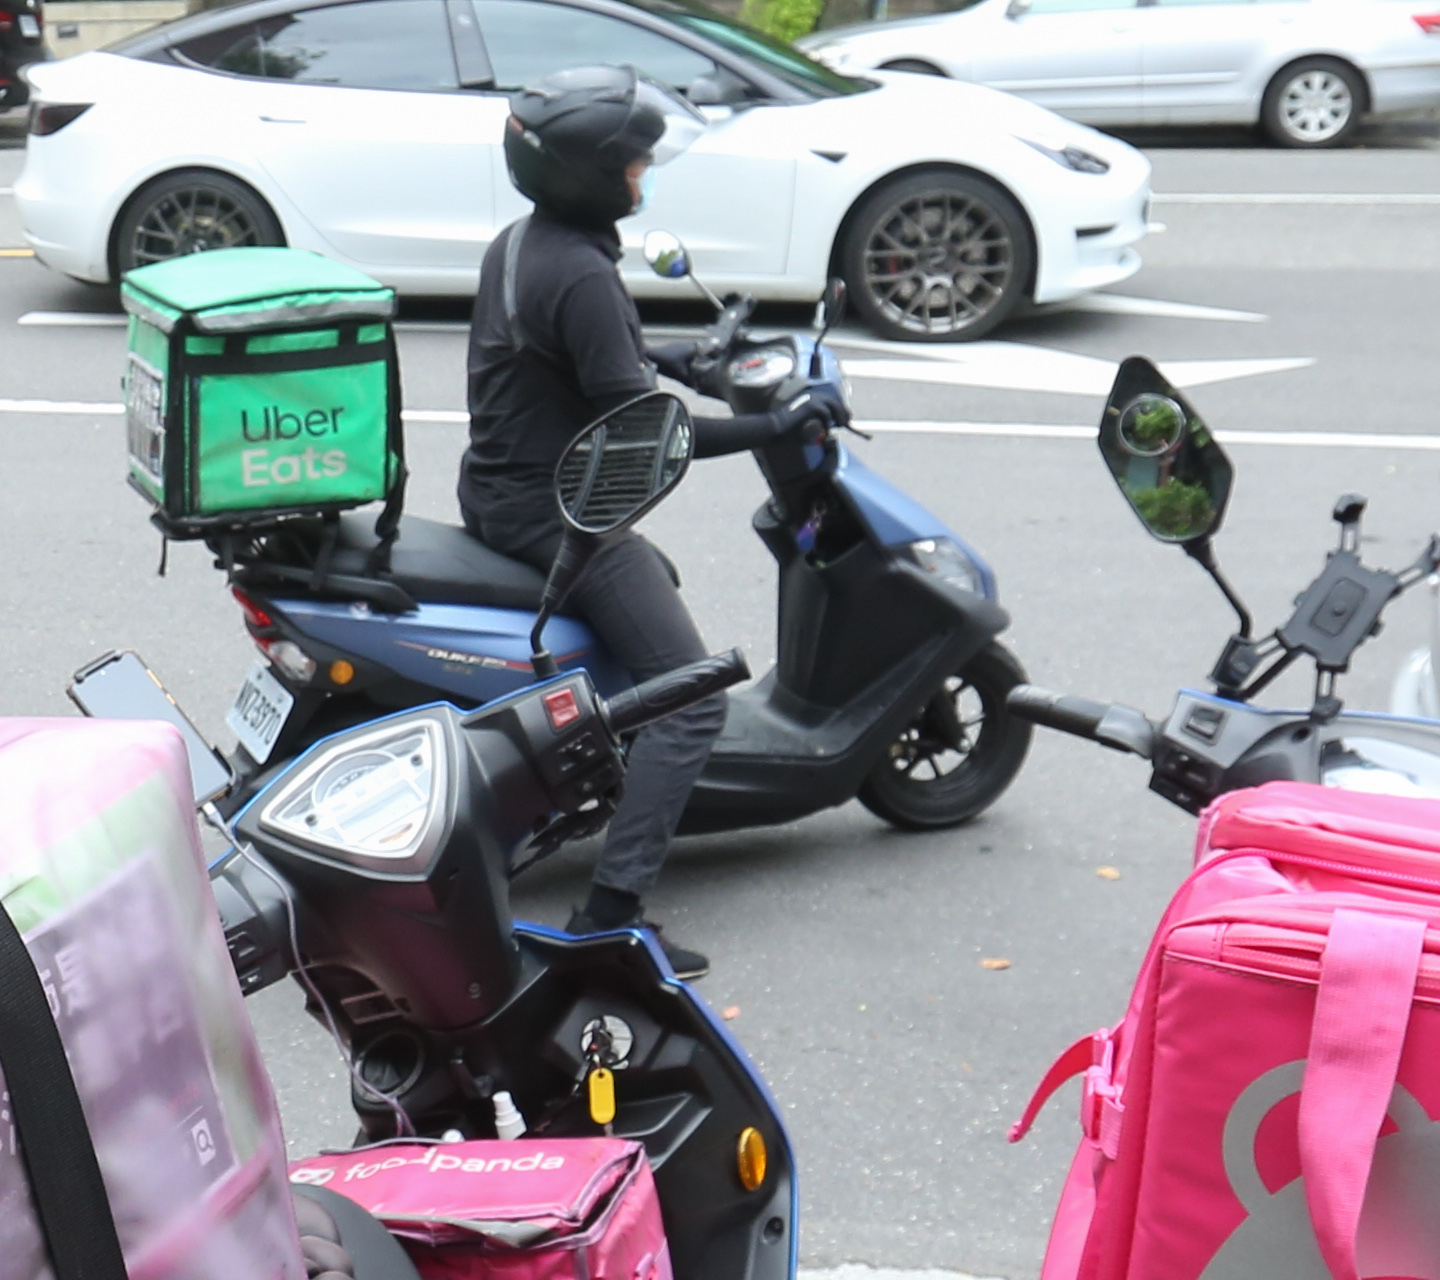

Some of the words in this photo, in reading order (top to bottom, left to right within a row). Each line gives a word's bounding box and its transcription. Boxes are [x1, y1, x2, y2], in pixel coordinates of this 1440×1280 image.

[241, 406, 344, 442] Uber
[241, 447, 348, 487] Eats
[342, 1147, 567, 1183] foodpanda
